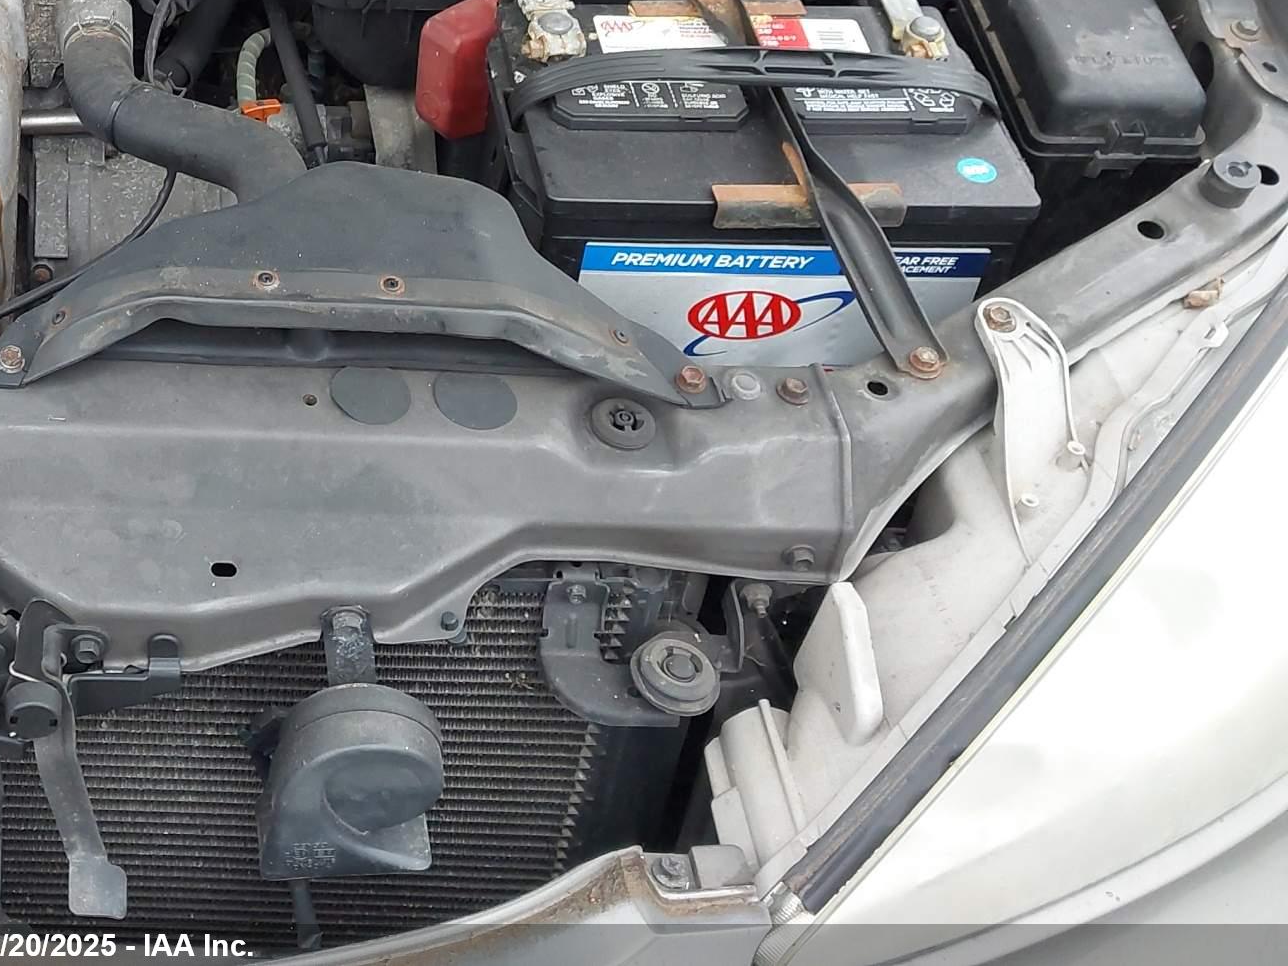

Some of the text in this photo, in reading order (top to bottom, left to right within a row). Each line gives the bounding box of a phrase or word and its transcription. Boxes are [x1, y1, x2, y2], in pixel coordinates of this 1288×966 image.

[611, 252, 815, 270] PREMIUM BATTERY
[894, 256, 959, 266] EAR FREE
[901, 265, 953, 274] ACEMENT
[697, 291, 795, 339] AAA
